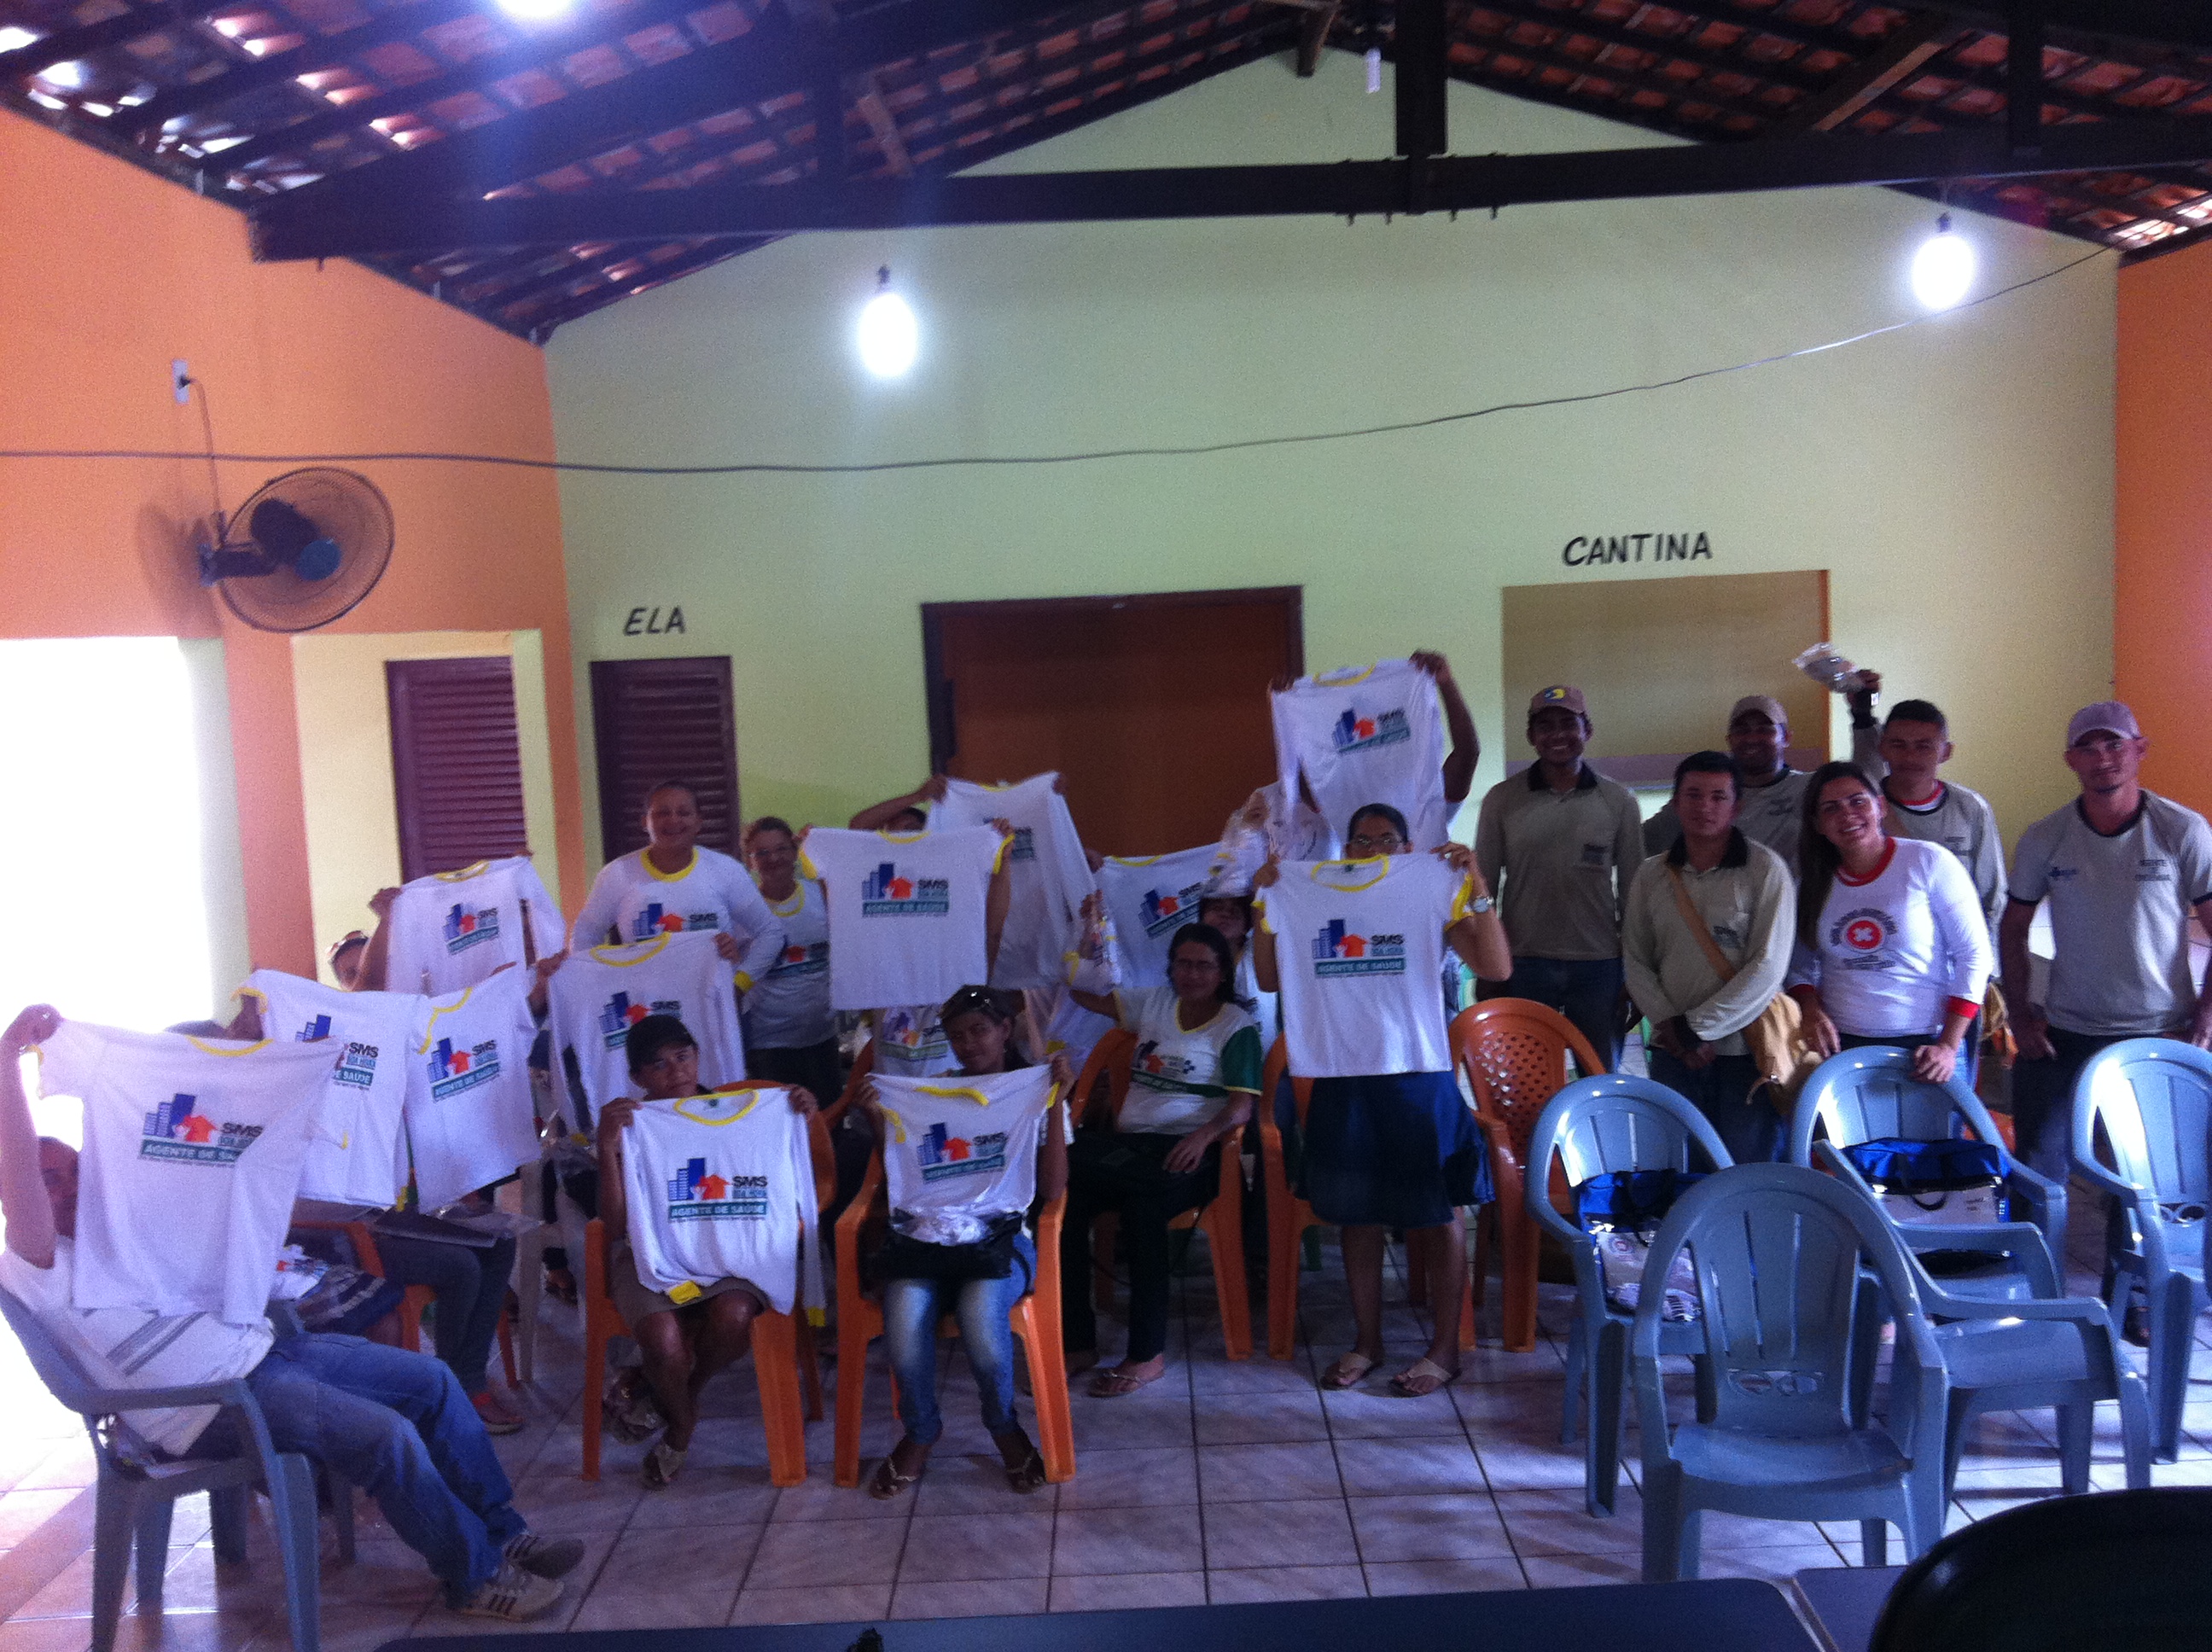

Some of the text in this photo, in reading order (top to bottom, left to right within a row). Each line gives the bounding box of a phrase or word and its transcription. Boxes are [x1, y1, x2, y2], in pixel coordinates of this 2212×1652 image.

[1562, 531, 1713, 567] CANTINA
[623, 606, 685, 637] ELA
[917, 878, 949, 889] SMS
[689, 912, 718, 922] SMS
[1371, 934, 1404, 945] SMS
[349, 1042, 379, 1058] SMS
[221, 1122, 264, 1137] SMS
[732, 1175, 767, 1187] SMS
[671, 1205, 713, 1218] AGENTE
[715, 1206, 728, 1215] DE
